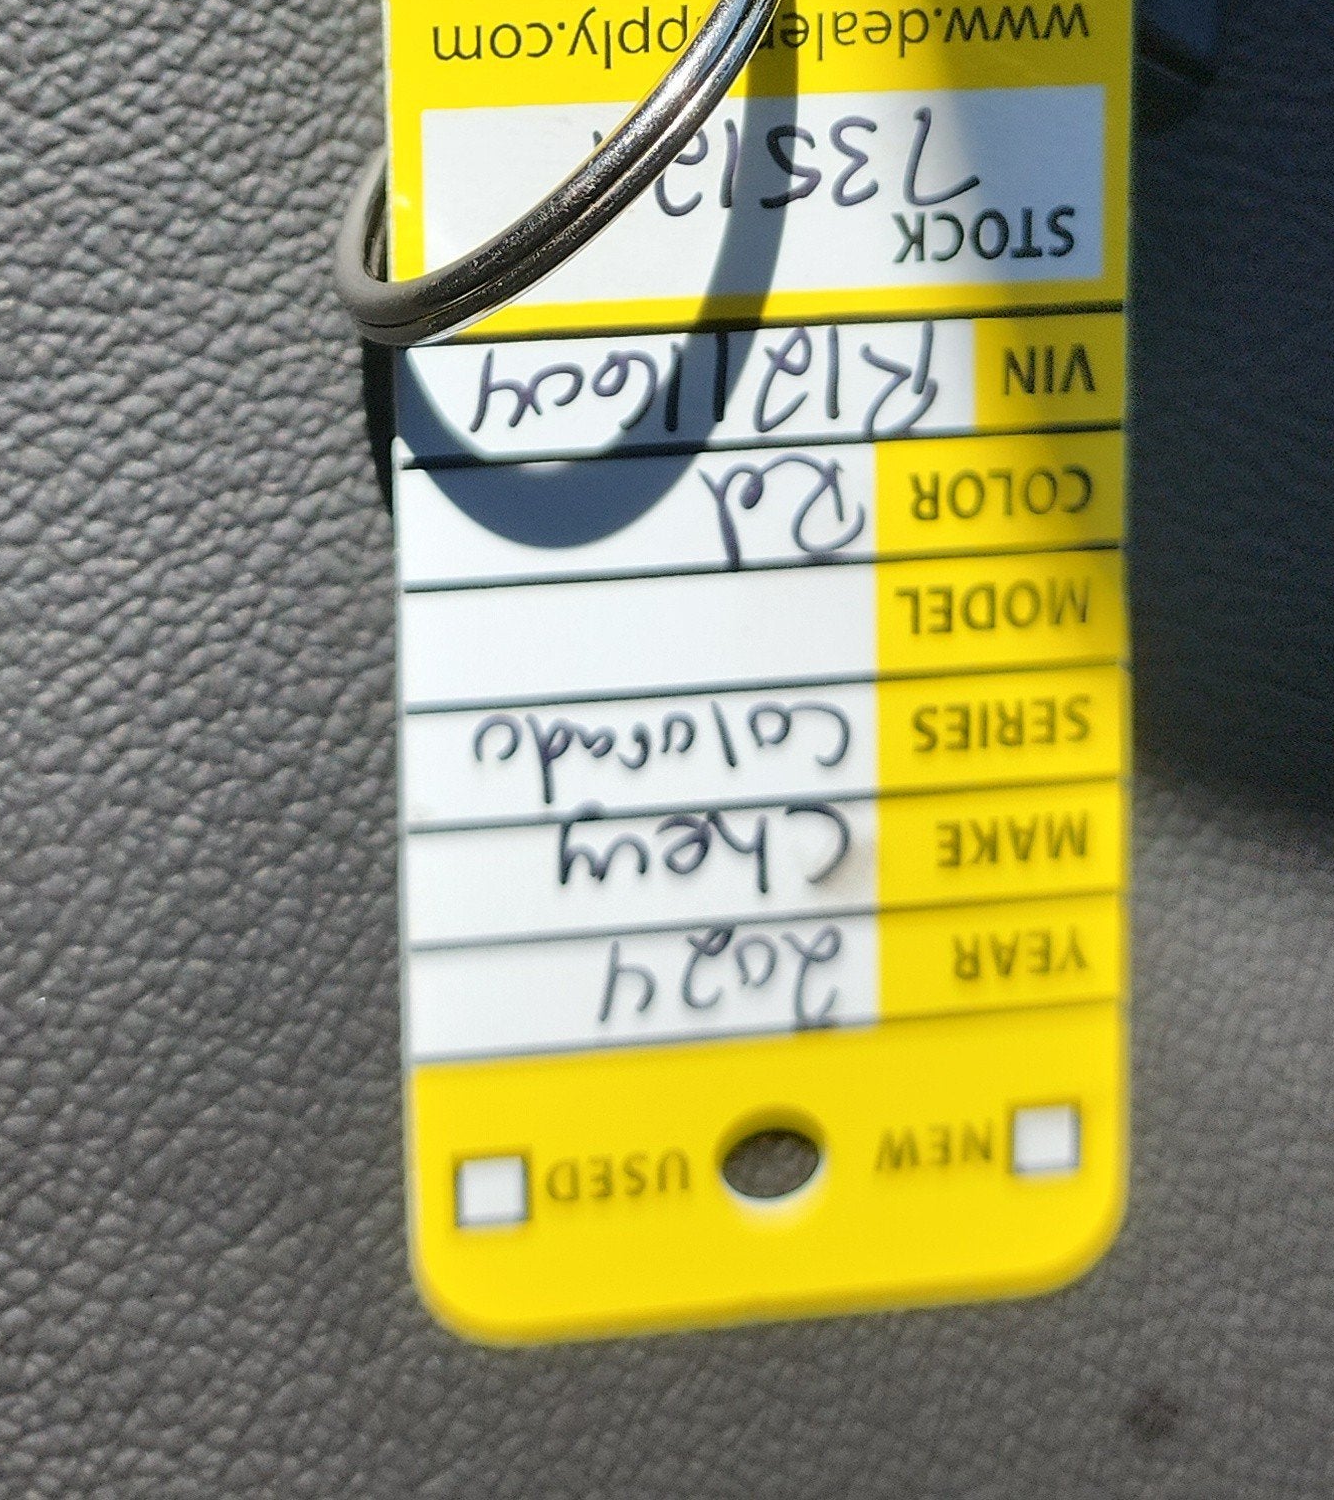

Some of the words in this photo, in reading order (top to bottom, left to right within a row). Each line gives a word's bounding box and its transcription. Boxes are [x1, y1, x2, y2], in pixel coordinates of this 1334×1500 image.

[432, 2, 1090, 70] www.dealerpply.com
[593, 108, 981, 218] 73512
[892, 206, 1076, 264] STOCK
[1002, 345, 1097, 398] VIN
[911, 467, 1094, 522] COLOR
[897, 577, 1090, 636] MODEL
[473, 701, 851, 804] Colorado
[913, 694, 1091, 753] SERIES
[557, 803, 853, 893] Chevy
[936, 812, 1089, 869] MAKE
[599, 925, 844, 1032] 2024
[952, 926, 1089, 982] YEAR
[875, 1118, 994, 1172] NEW
[545, 1152, 693, 1204] USED
